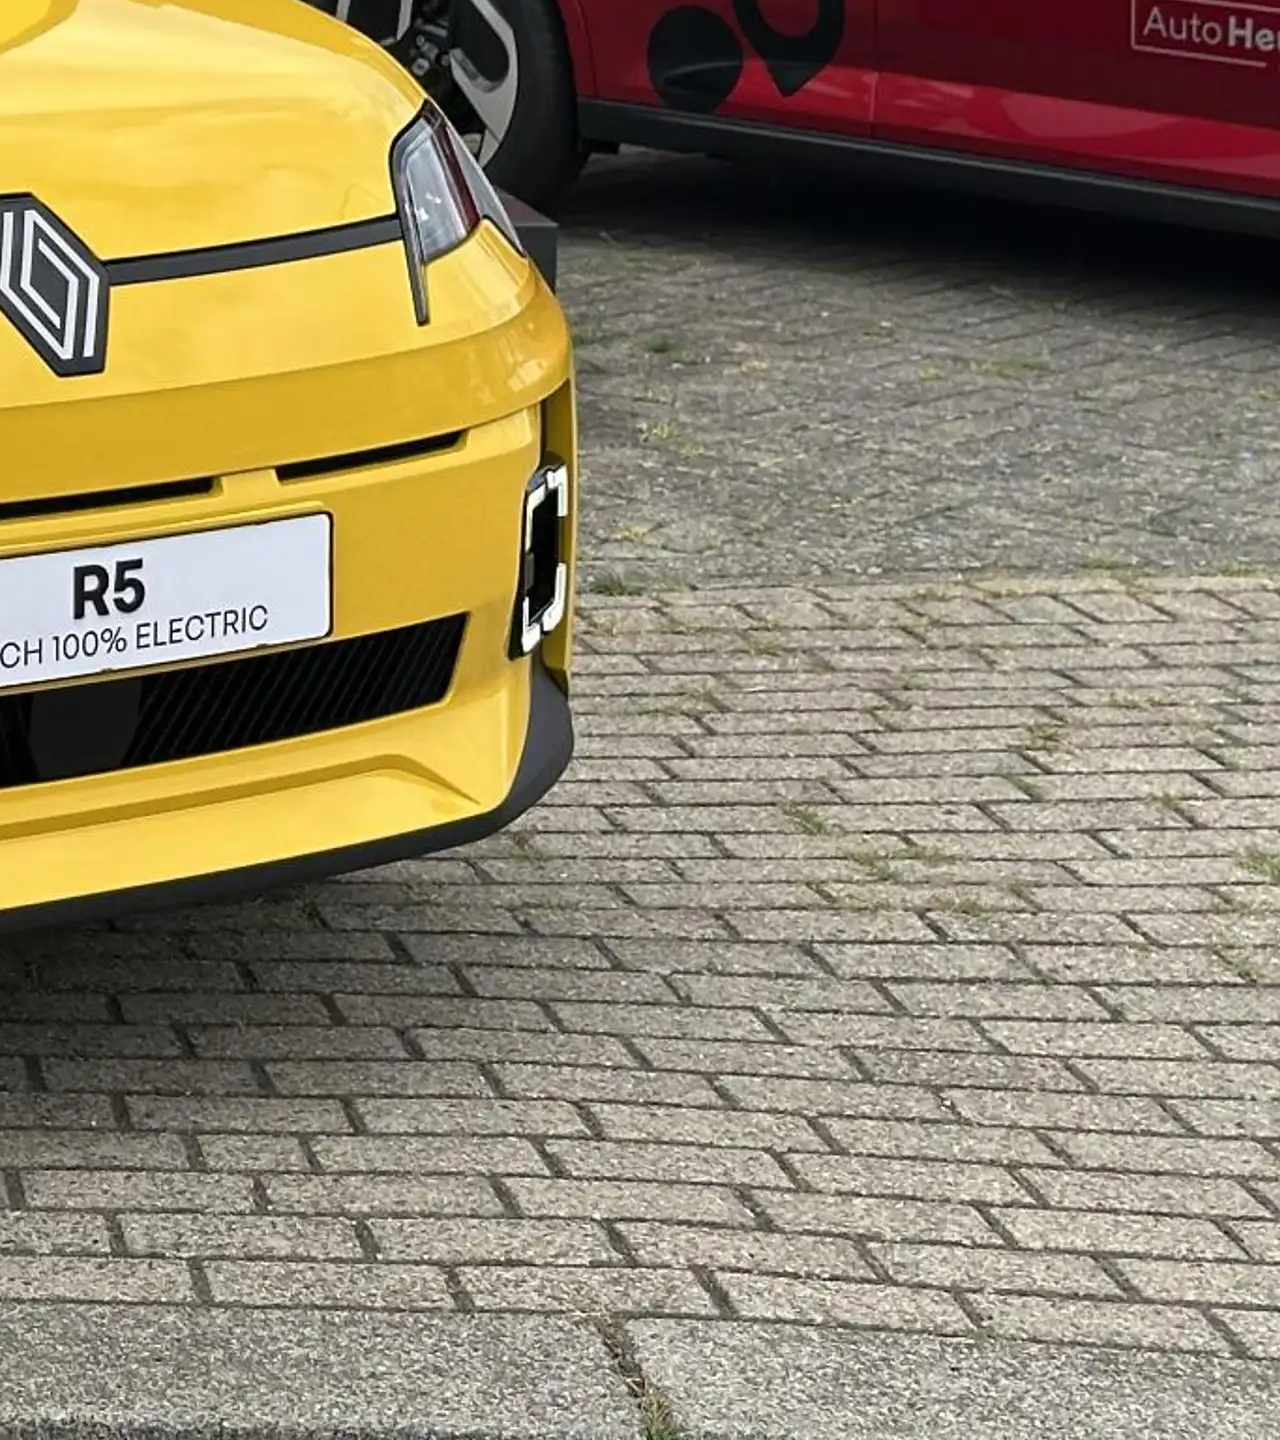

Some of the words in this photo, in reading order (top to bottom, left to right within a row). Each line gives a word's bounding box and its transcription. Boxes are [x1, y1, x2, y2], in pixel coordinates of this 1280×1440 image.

[1142, 6, 1280, 52] AutoHe
[72, 558, 146, 620] R5
[52, 625, 127, 662] 100%
[136, 605, 269, 650] ELECTRIC
